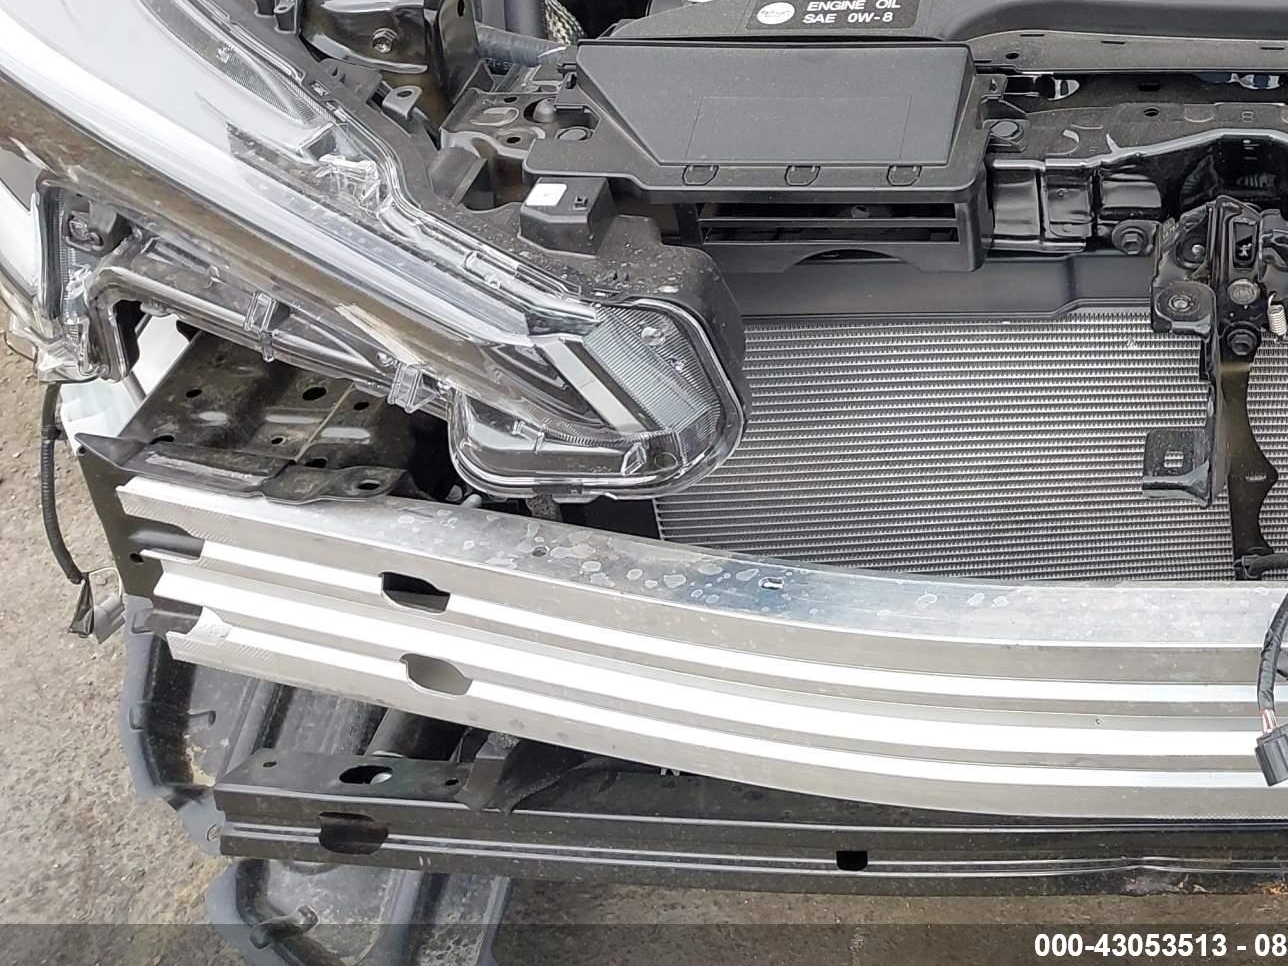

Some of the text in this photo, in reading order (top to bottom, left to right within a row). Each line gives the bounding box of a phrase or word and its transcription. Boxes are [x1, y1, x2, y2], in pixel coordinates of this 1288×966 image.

[806, 0, 867, 12] ENGINE
[802, 11, 893, 24] SAE 0W-8
